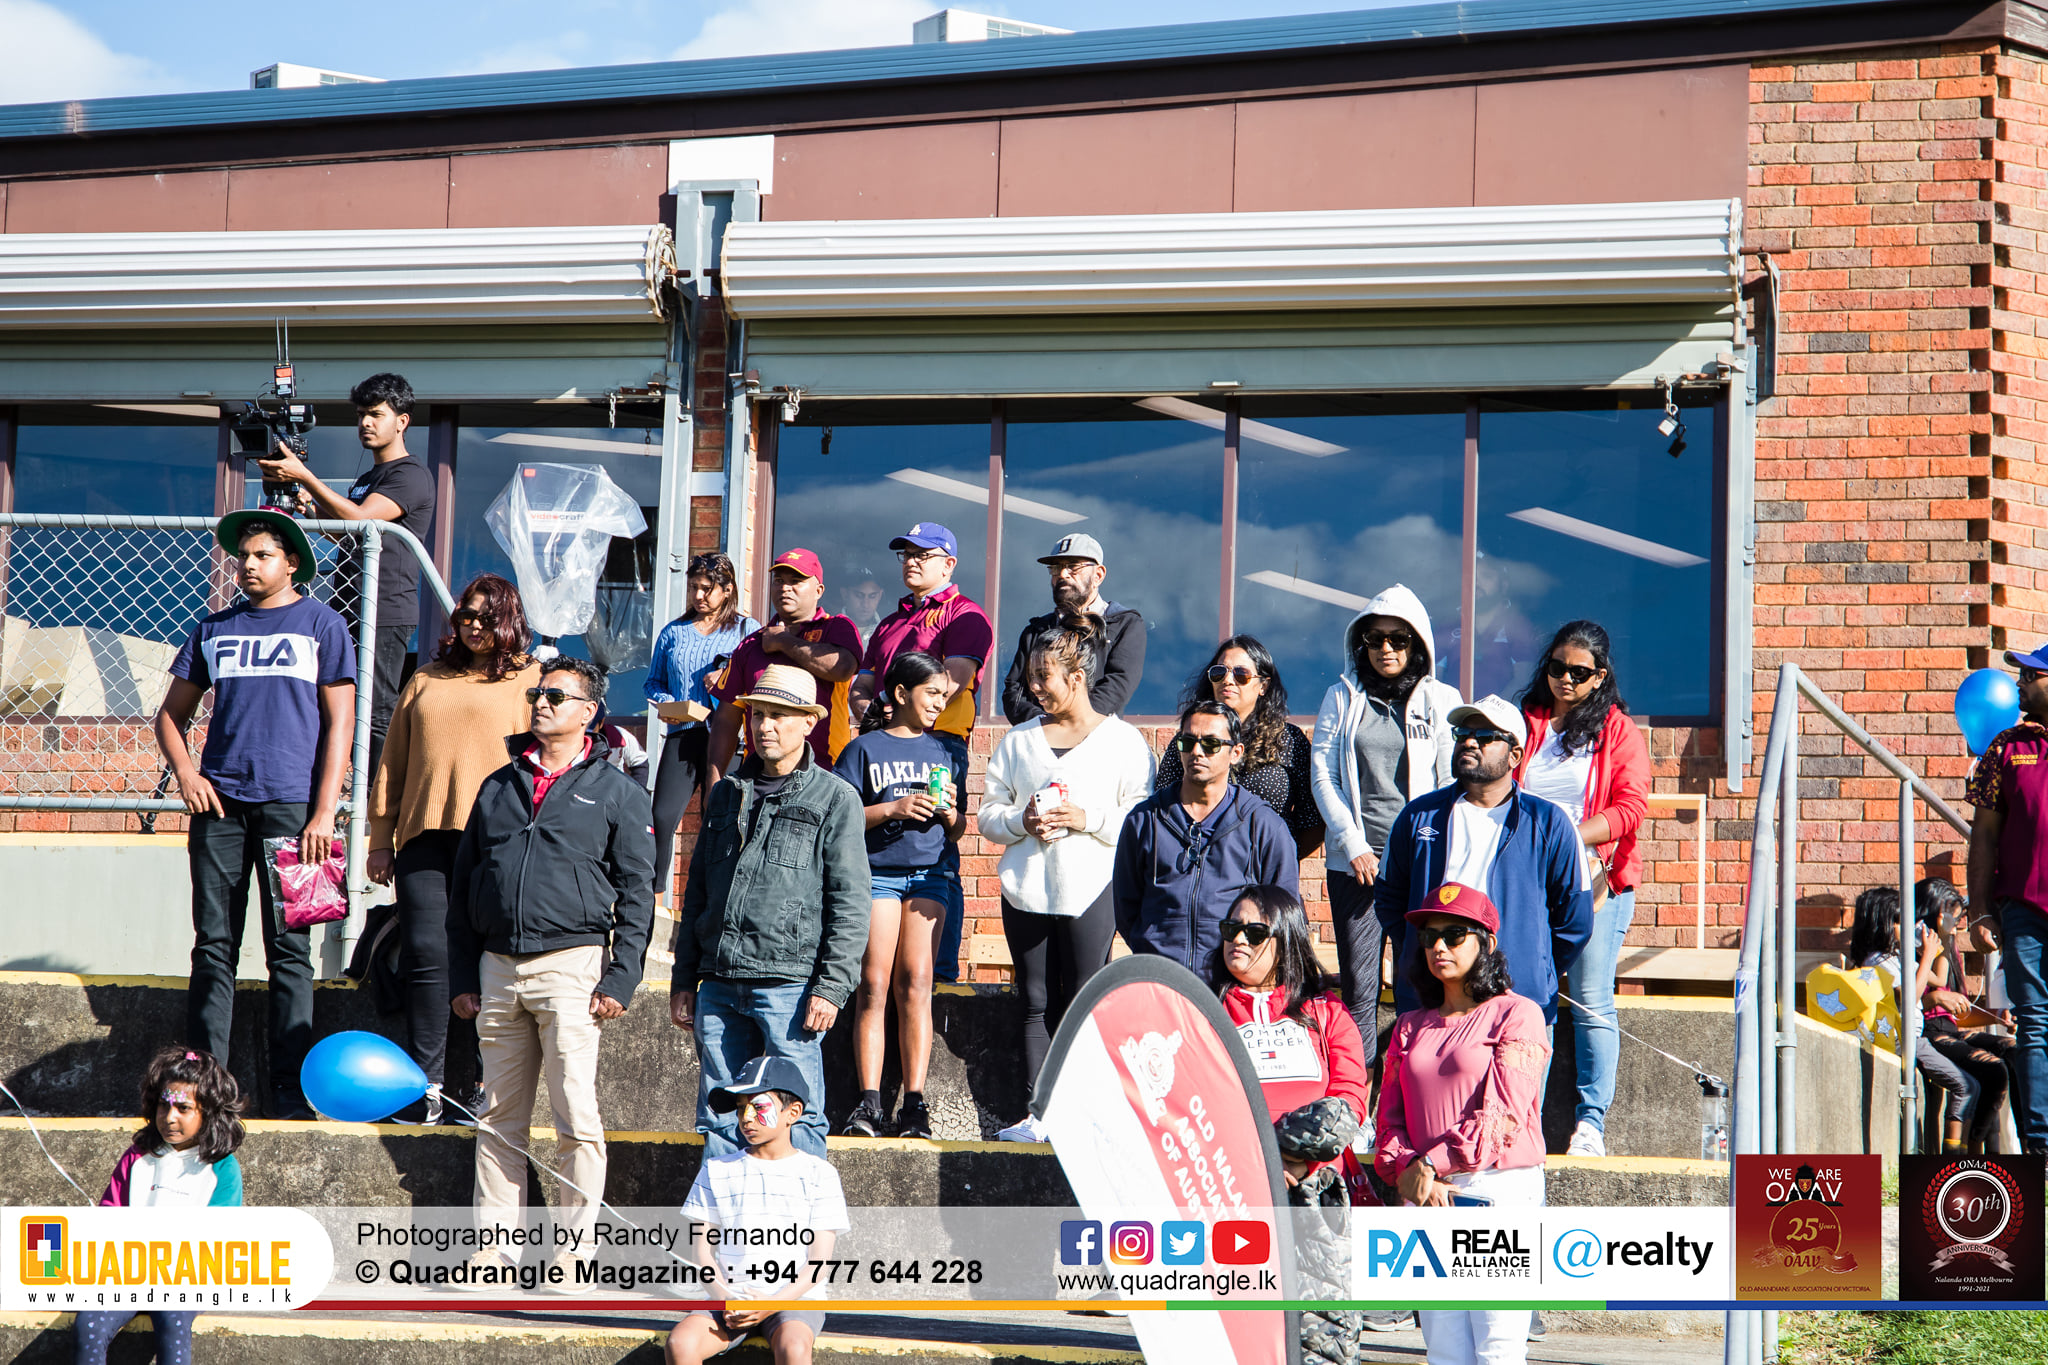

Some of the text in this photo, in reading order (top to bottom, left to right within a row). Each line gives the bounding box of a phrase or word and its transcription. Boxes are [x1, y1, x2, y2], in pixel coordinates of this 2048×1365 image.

[215, 638, 298, 669] FILA
[869, 761, 935, 794] OAKLA
[1242, 1024, 1297, 1039] OMMY
[1247, 1036, 1305, 1049] LFIGER
[1189, 1095, 1215, 1142] OLD
[1161, 1132, 1182, 1162] OF
[1174, 1116, 1231, 1221] ASSOCIAT
